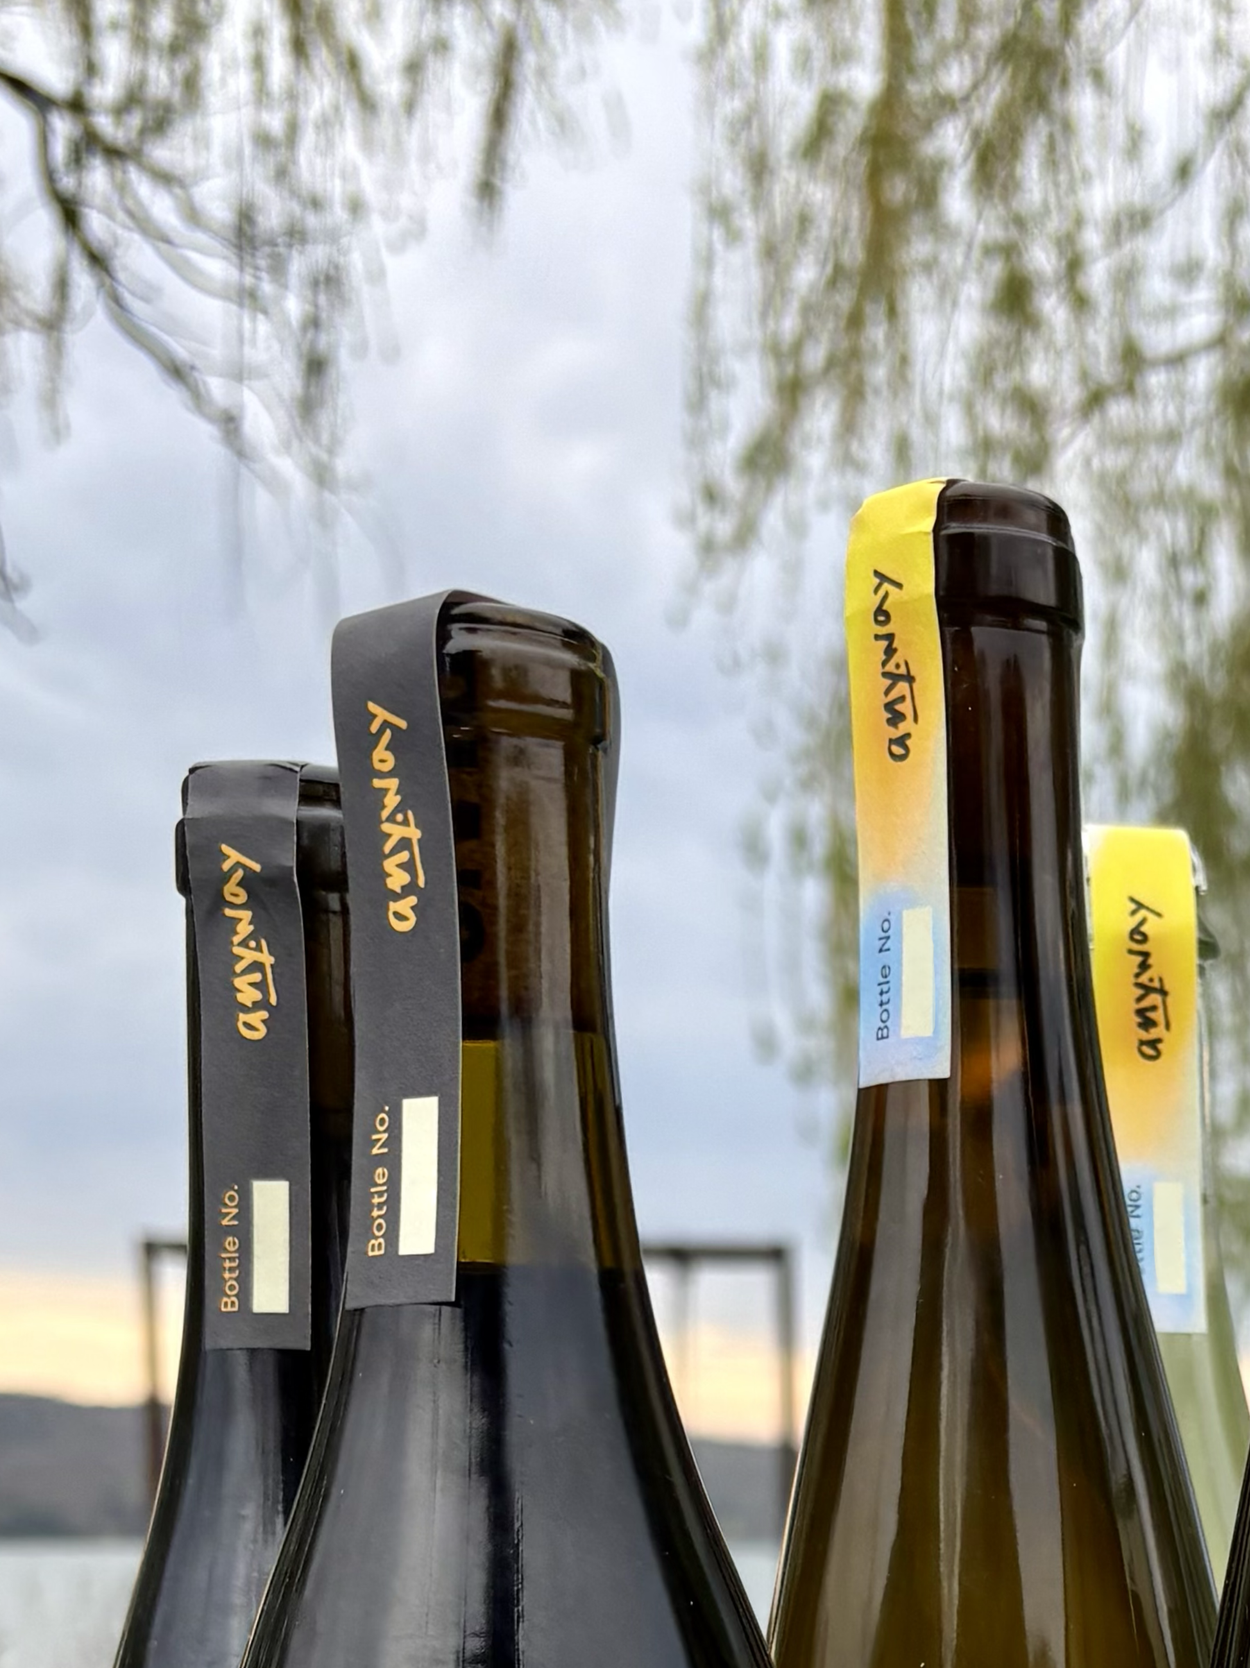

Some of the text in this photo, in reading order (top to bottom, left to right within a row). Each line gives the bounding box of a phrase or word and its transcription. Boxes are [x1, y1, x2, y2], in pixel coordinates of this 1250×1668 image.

[876, 911, 892, 1041] Bottle No.
[367, 1105, 389, 1257] Bottle No.
[220, 1184, 239, 1312] Bottle No.
